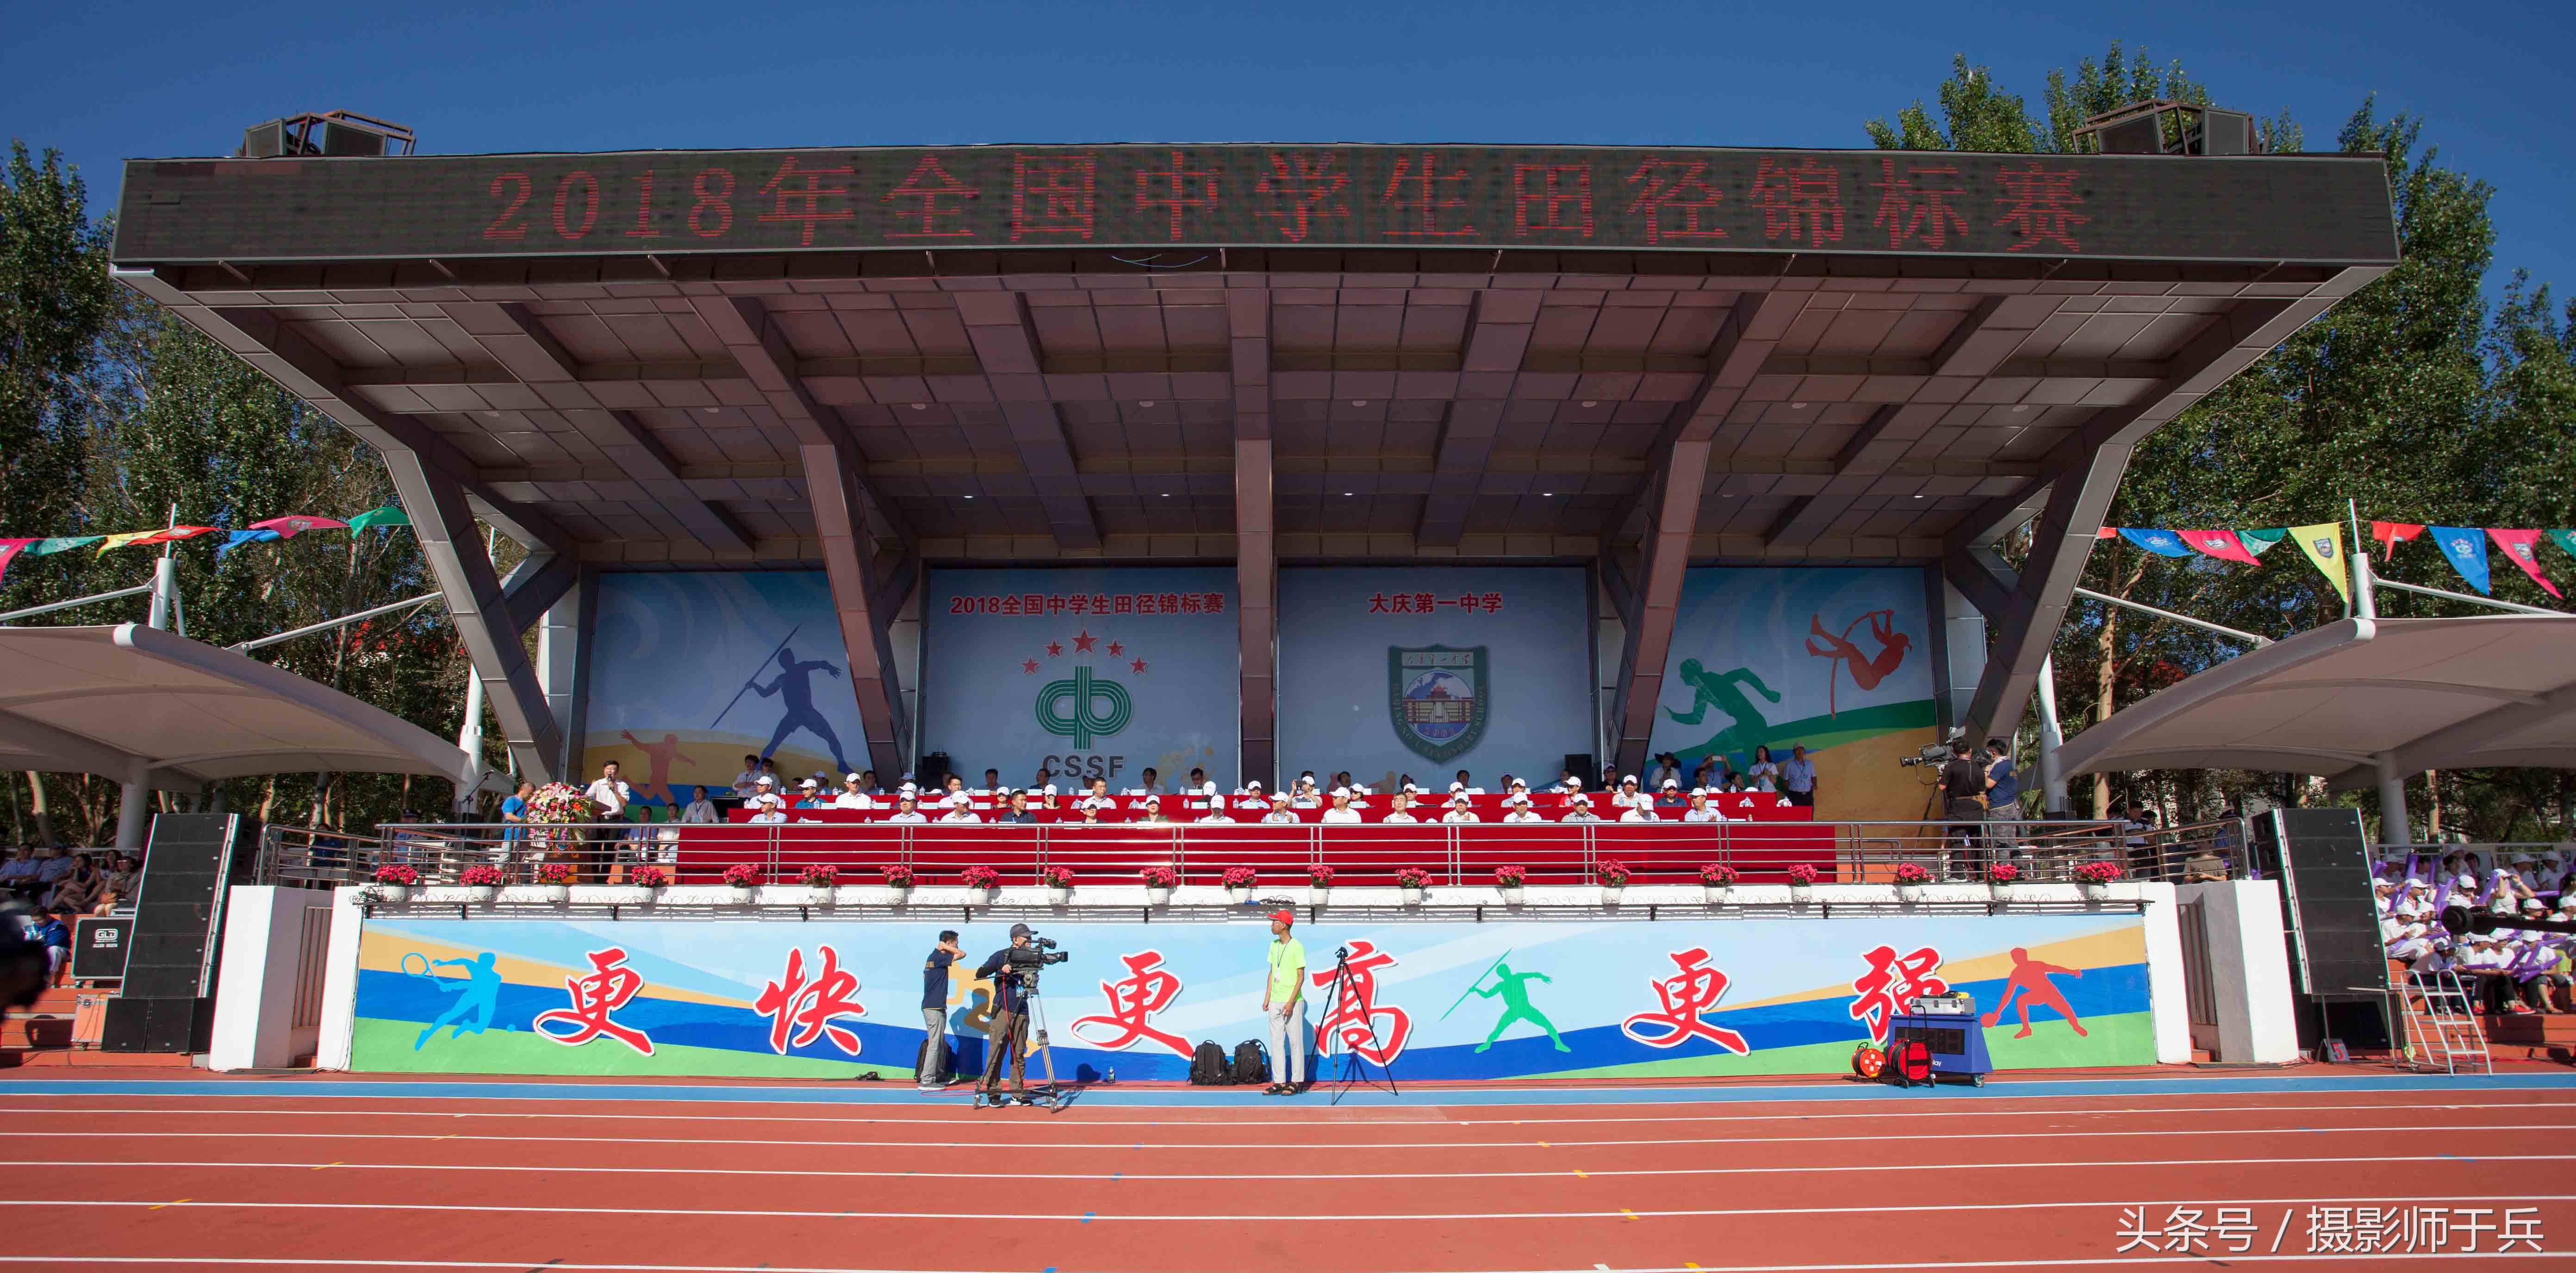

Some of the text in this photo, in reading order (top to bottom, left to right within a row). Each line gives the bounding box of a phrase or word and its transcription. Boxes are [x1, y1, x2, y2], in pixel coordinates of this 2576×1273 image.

[483, 152, 2091, 252] 2018年全国中学生田径锦标赛
[949, 593, 1225, 616] 2018全国中学生田径锦标赛
[1368, 592, 1504, 615] 大庆第一中学
[1042, 755, 1125, 778] CSSF
[2332, 1043, 2345, 1062] 5
